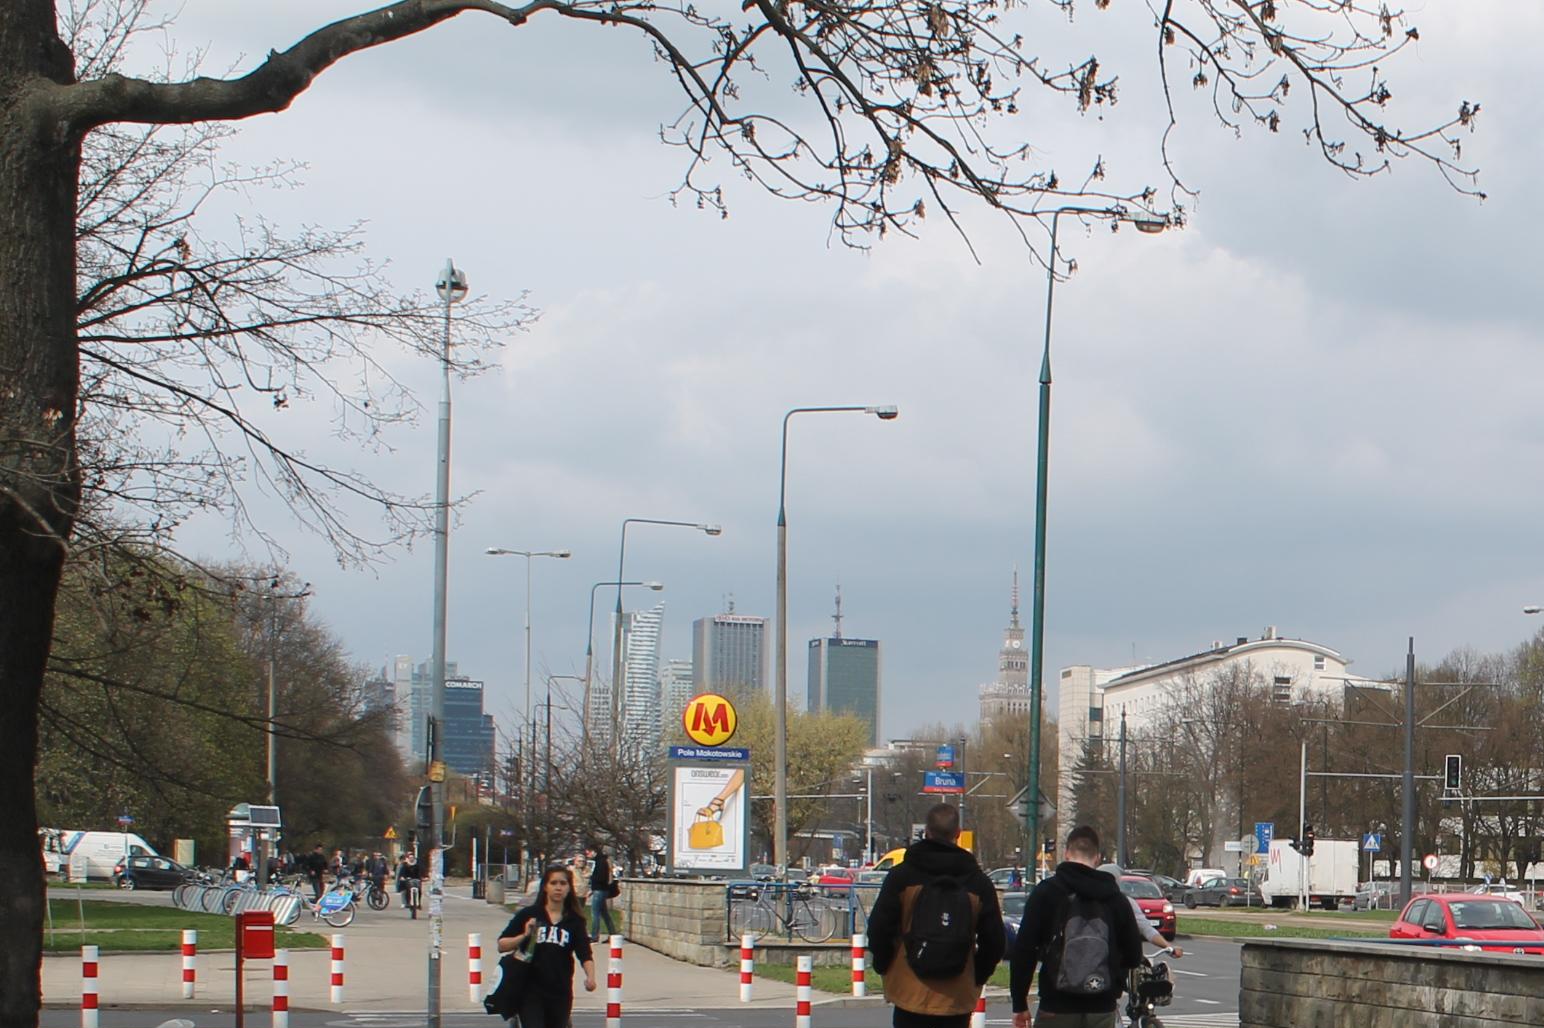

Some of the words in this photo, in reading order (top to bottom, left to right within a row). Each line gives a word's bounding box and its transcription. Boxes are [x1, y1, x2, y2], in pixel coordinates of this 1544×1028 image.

[445, 681, 482, 689] COMARCH
[677, 748, 695, 757] Pole
[696, 749, 742, 758] Mokotowskie
[935, 776, 956, 786] Bruna
[537, 926, 570, 948] GAP
